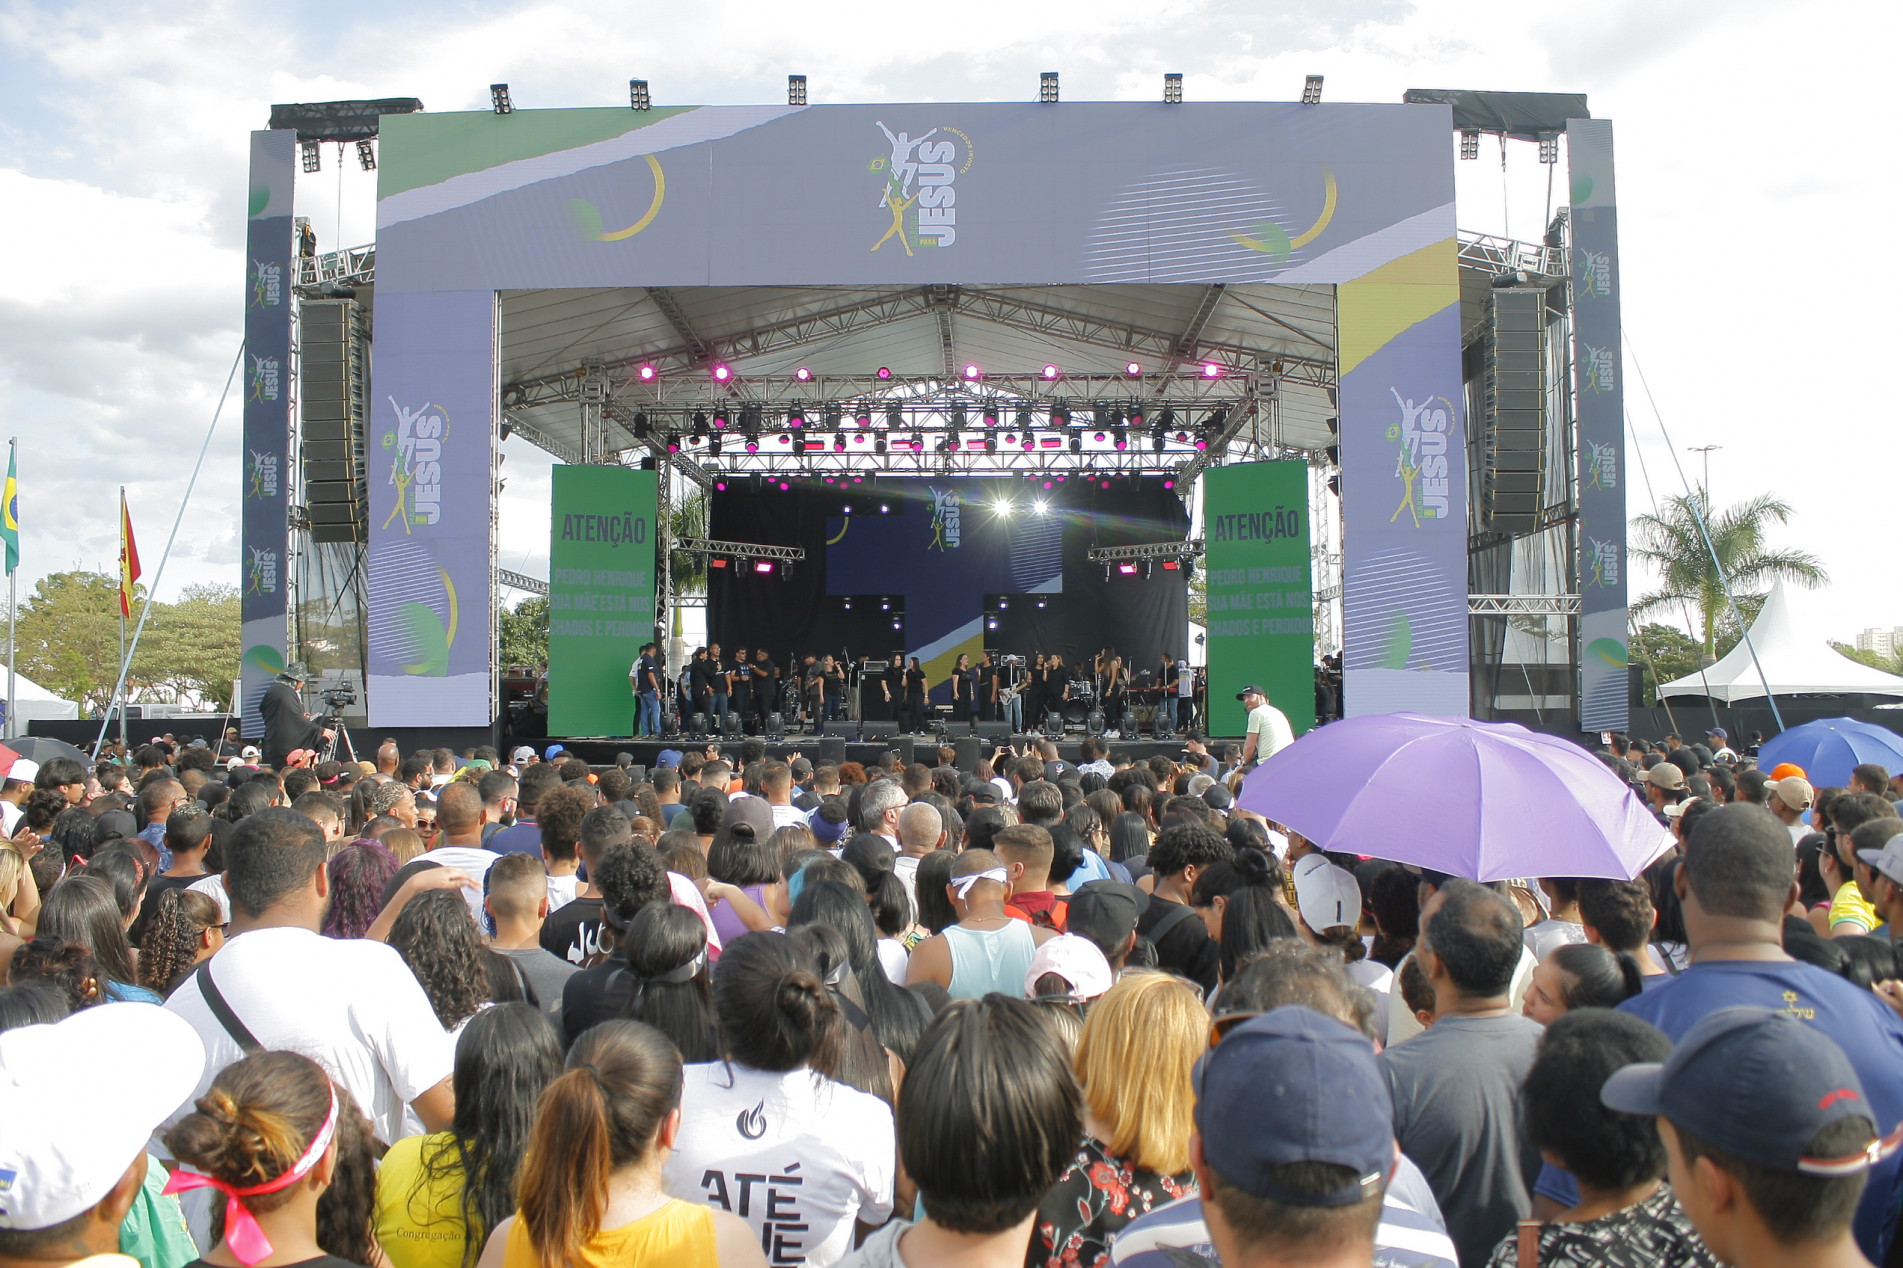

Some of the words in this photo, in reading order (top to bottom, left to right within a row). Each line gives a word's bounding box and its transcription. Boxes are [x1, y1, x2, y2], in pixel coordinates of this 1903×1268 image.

[918, 141, 956, 247] JESUS
[266, 265, 281, 306] JESUS
[1596, 255, 1611, 296] JESUS
[264, 360, 279, 401] JESUS
[1599, 351, 1614, 391] JESUS
[262, 456, 278, 497] JESUS
[415, 415, 442, 525] JESUS
[1420, 408, 1449, 519] JESUS
[1602, 447, 1617, 488] JESUS
[561, 511, 646, 548] ATENÇÃO
[945, 495, 960, 548] JESUS
[1214, 505, 1299, 544] ATENÇÃO
[262, 552, 277, 593] JESUS
[554, 568, 590, 586] PEDRO
[593, 569, 647, 588] HENRIQUE
[1210, 568, 1245, 586] PEDRO
[1248, 565, 1303, 585] HENRIQUE
[1604, 544, 1618, 585] JESUS
[550, 594, 571, 610] SUA
[574, 591, 598, 611] MÃE
[600, 592, 627, 612] ESTÁ
[629, 596, 650, 612] NOS
[1208, 595, 1228, 611] SUA
[1230, 590, 1254, 611] MÃE
[1256, 589, 1284, 609] ESTÁ
[1286, 591, 1309, 608] NOS
[596, 620, 602, 636] E
[1253, 619, 1260, 635] E
[701, 1161, 803, 1221] ATÉ
[396, 1227, 461, 1243] Congregação
